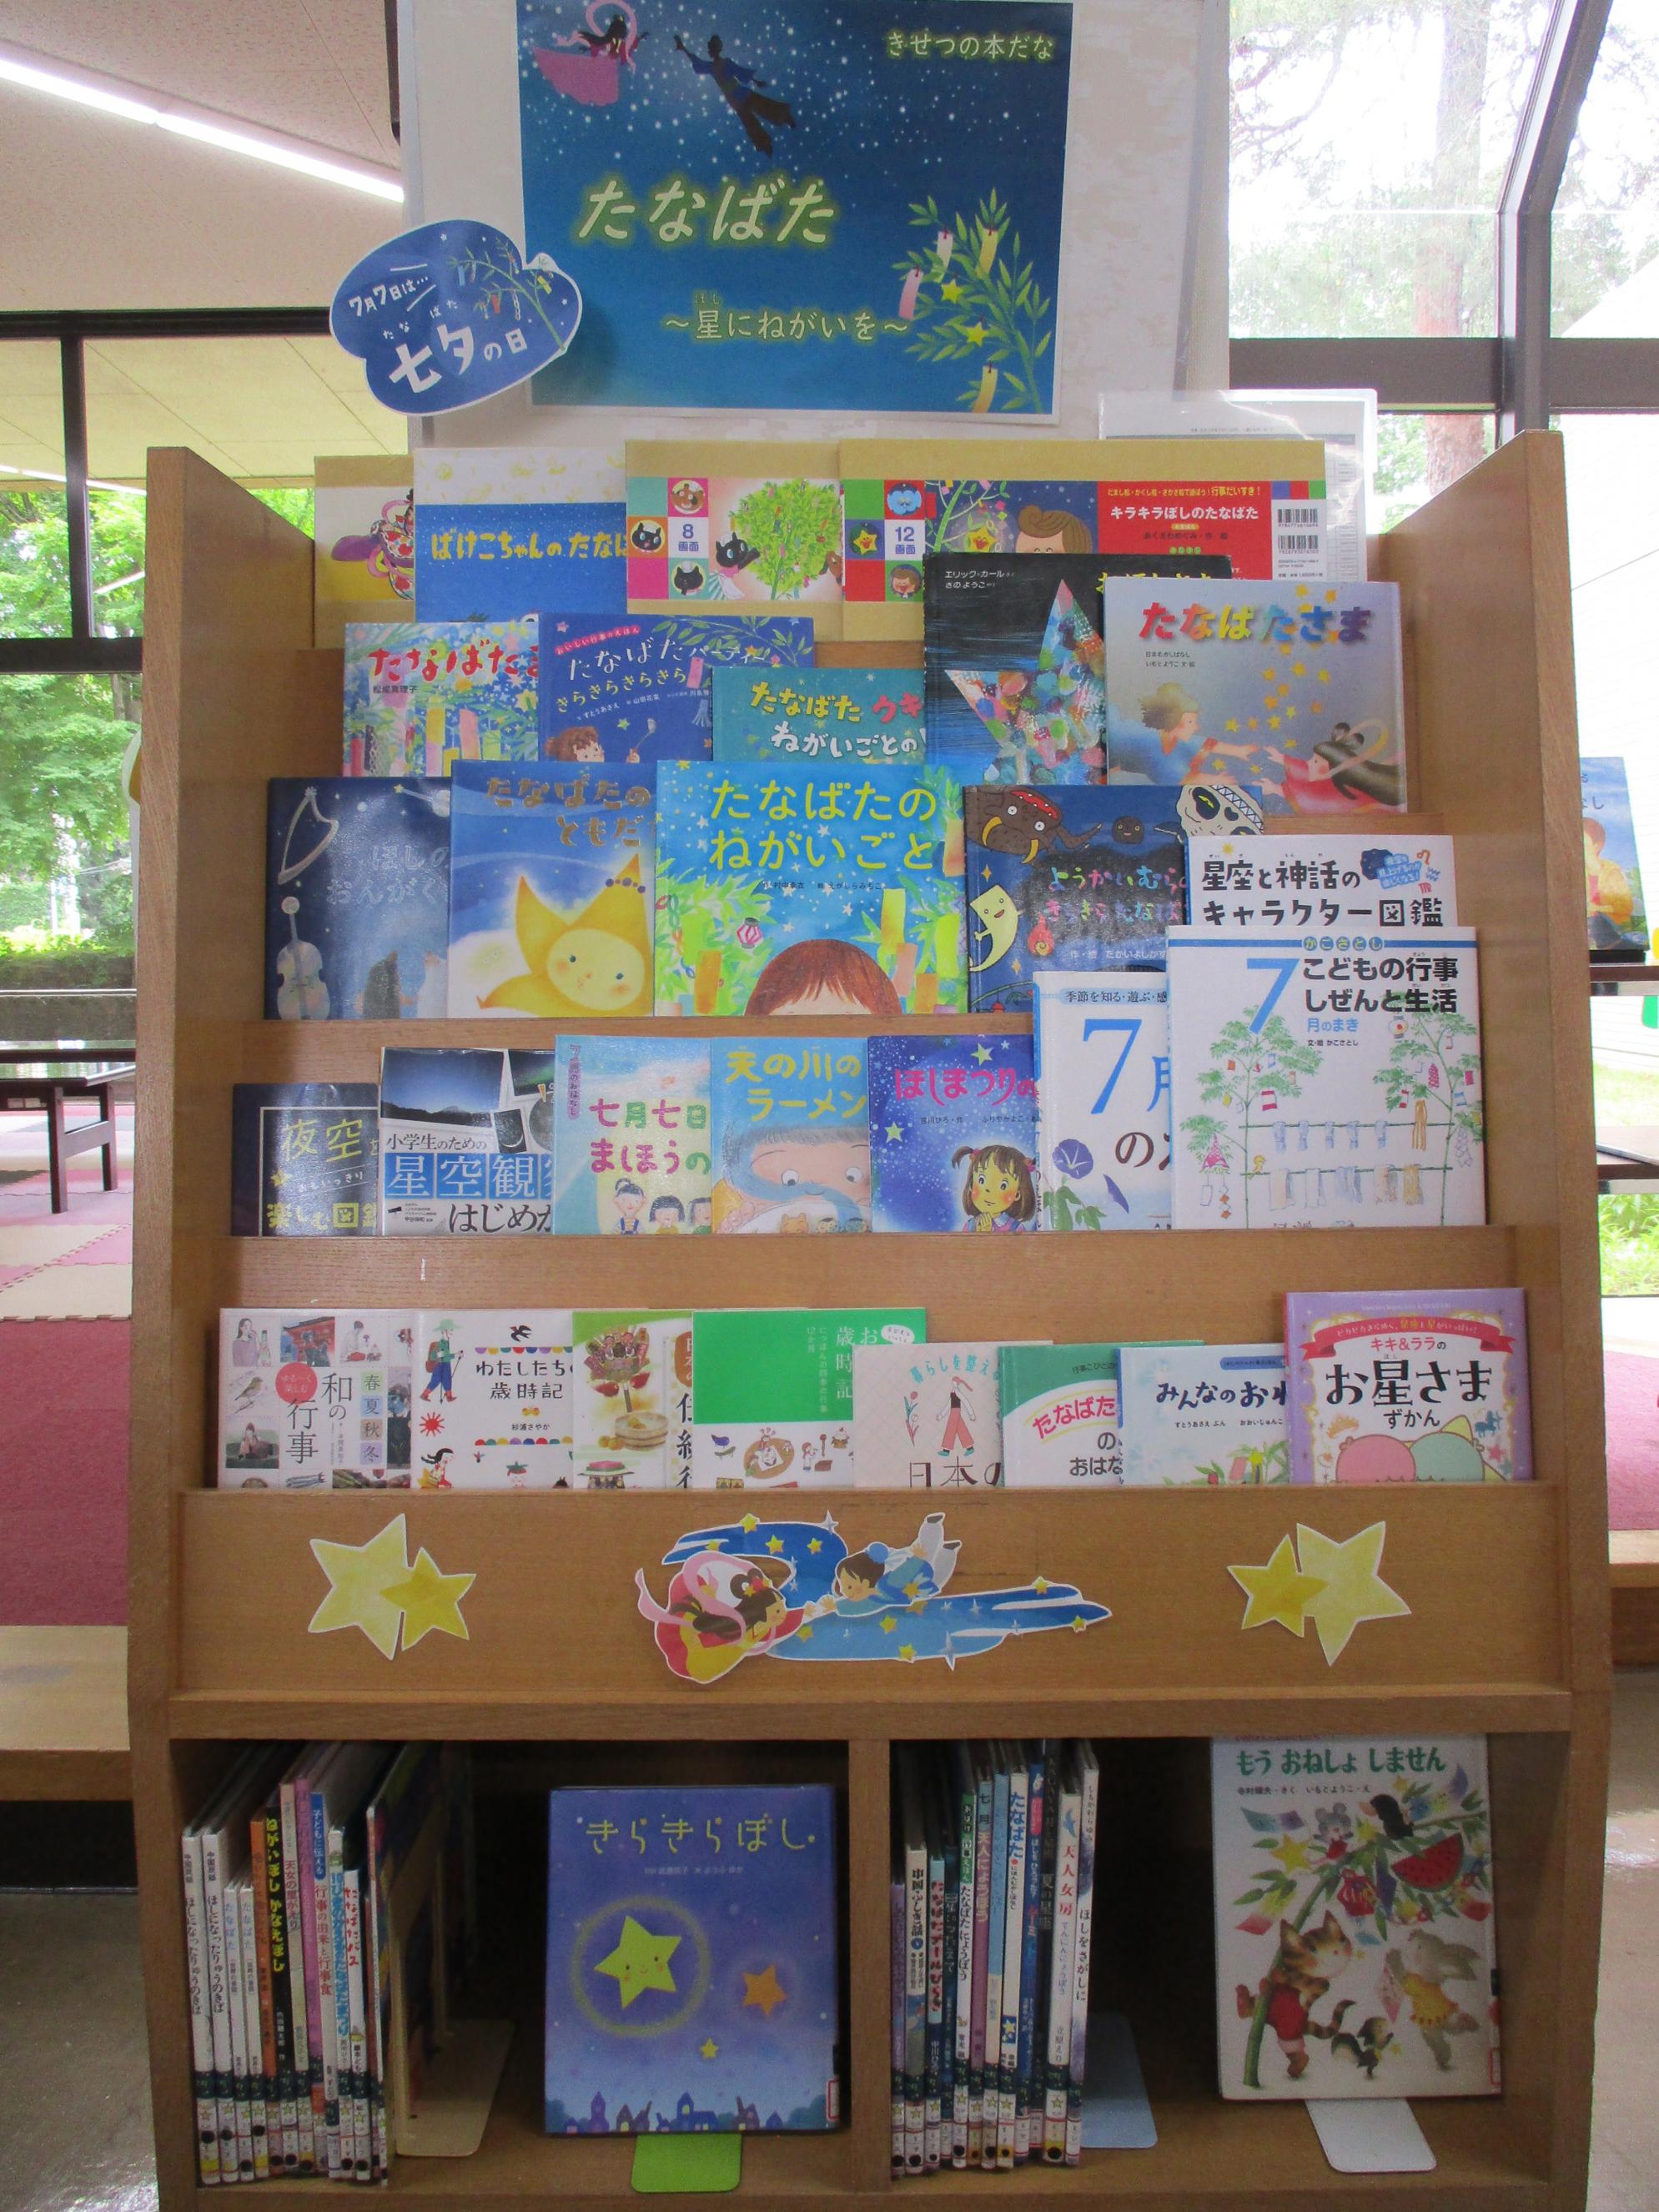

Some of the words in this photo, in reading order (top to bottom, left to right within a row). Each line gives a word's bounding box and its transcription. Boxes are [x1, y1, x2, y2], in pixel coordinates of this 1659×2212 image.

[886, 30, 1053, 63] きせつの本だな
[580, 178, 836, 244] たなばた
[389, 323, 528, 394] 七夕の日
[1110, 506, 1259, 520] キラキラぼしのたなばた
[678, 542, 699, 552] 画面
[682, 524, 694, 539] 8
[894, 525, 914, 541] 12
[895, 545, 915, 554] 画面
[1139, 601, 1370, 644] たなばたさま
[556, 667, 686, 713] きらきらきらきら
[751, 681, 862, 722] たなばた
[771, 721, 926, 758] ねがいごとの
[486, 773, 651, 811] たなばたの
[711, 779, 937, 821] たなばたの
[556, 813, 656, 847] ともだ
[709, 830, 933, 871] ねがいごと
[327, 877, 449, 906] おんがく
[1202, 860, 1360, 891] 星座と神話の
[1202, 897, 1443, 927] キャラクター図鑑
[1304, 937, 1384, 950] かこさとし
[1303, 957, 1458, 982] こどもの行事
[1246, 958, 1300, 1034] 7
[1305, 988, 1457, 1013] しぜんと生活
[1307, 1018, 1360, 1033] 月のまき
[725, 1049, 862, 1083] 天の川の
[895, 1067, 1036, 1107] ほしまつりの
[589, 1098, 706, 1129] 七月七日
[747, 1088, 867, 1122] ラーメン
[386, 1134, 487, 1152] 小学生のための
[591, 1138, 711, 1174] まほうの
[1114, 1131, 1170, 1171] の
[386, 1154, 554, 1198] 星空観
[475, 1359, 574, 1377] わたしたち
[1325, 1360, 1492, 1407] お星さま
[321, 1372, 352, 1420] 和の
[490, 1382, 563, 1400] 歳時記
[286, 1398, 319, 1465] 行事
[511, 1423, 550, 1431] 杉浦さやか
[1032, 1396, 1117, 1440] たなばた
[1174, 1420, 1210, 1429] すとうあさえ
[1383, 1410, 1440, 1430] ずかん
[1098, 1431, 1117, 1451] の
[1237, 1749, 1272, 1777] もう
[1281, 1748, 1358, 1776] おねしょ
[1370, 1746, 1447, 1774] しません
[586, 1813, 806, 1855] きらきらぼし
[1008, 1792, 1026, 1859] たなばた
[1059, 1845, 1076, 1917] 天人女房
